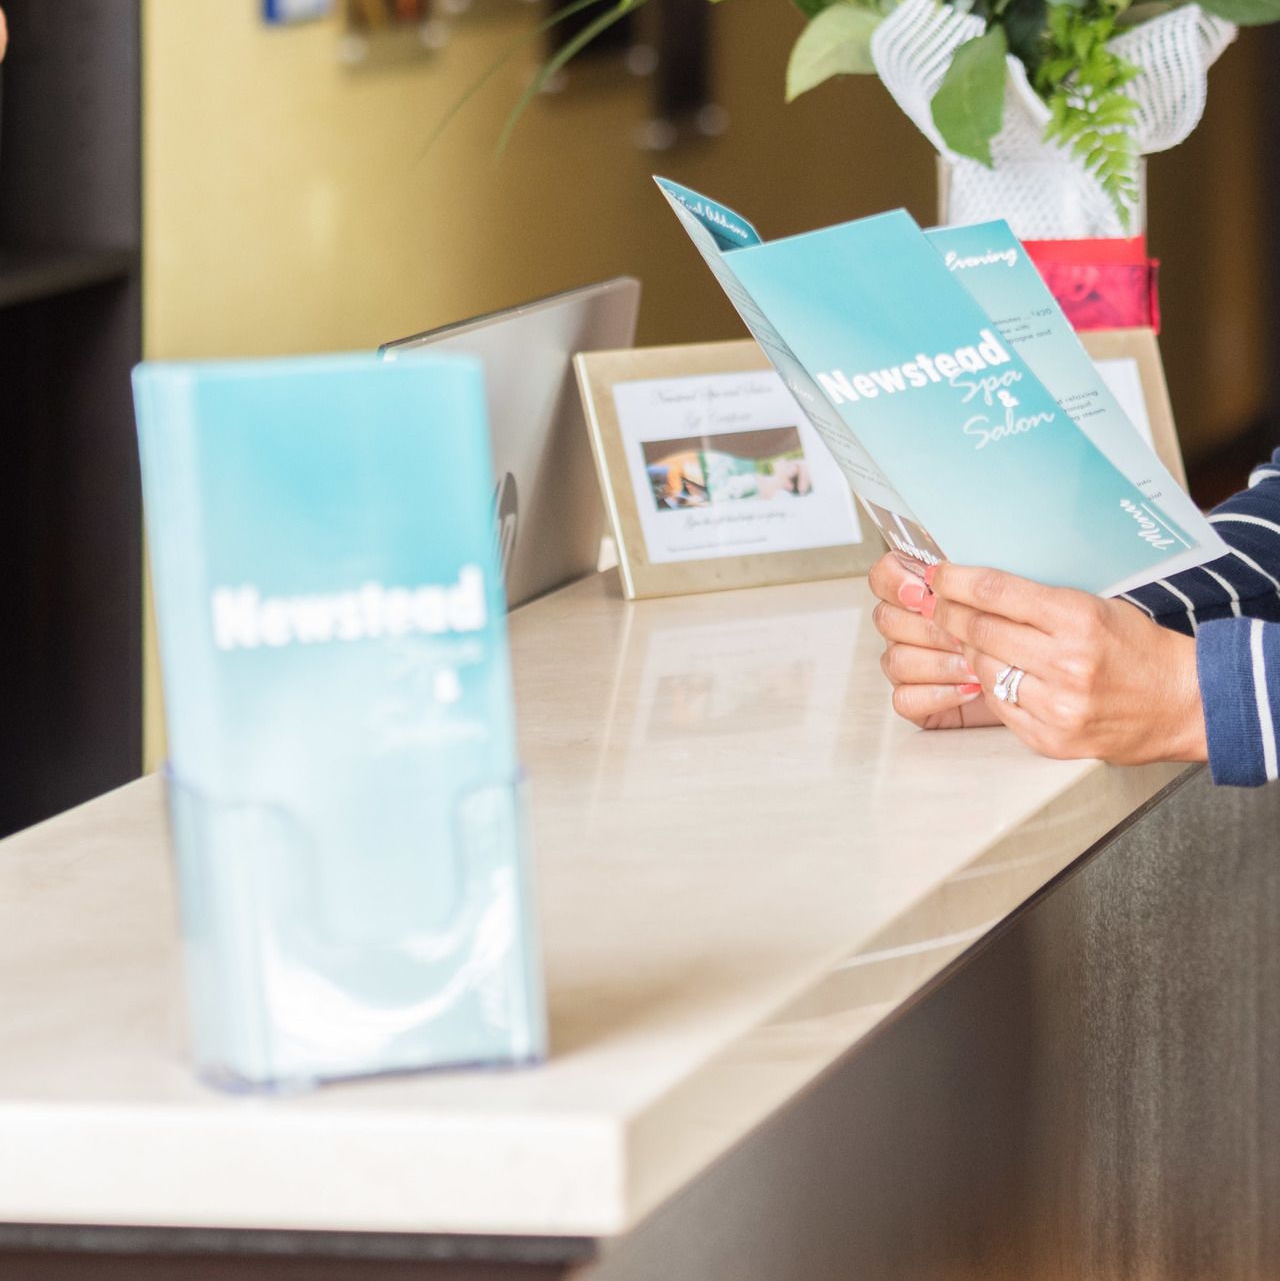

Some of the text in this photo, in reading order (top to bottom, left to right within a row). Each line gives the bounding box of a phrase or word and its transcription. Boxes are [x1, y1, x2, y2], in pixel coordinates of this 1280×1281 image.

[816, 328, 1011, 405] Newstead
[949, 370, 1022, 406] Spa
[997, 390, 1019, 408] &
[963, 407, 1056, 450] Salon
[212, 565, 486, 650] Newstead
